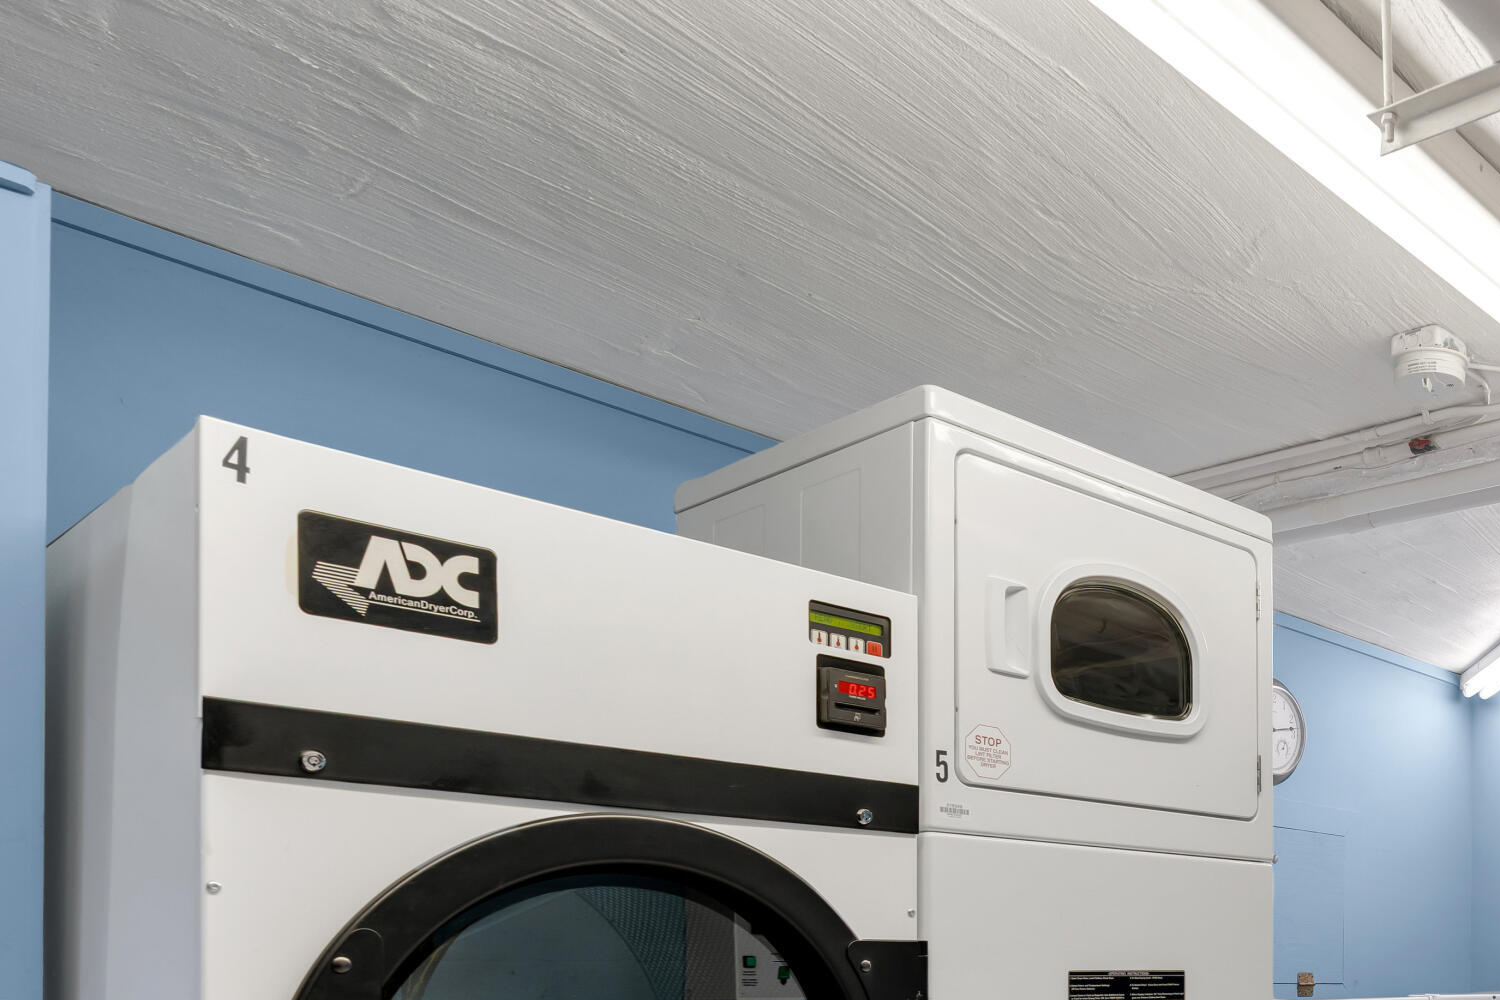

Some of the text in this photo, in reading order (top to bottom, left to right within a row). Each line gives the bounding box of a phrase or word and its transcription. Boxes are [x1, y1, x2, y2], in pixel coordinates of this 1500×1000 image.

[222, 435, 251, 484] 4
[354, 535, 480, 609] ADC
[368, 591, 478, 619] AmericanDryerCorp.
[975, 734, 1002, 748] STOP
[935, 749, 949, 783] 5
